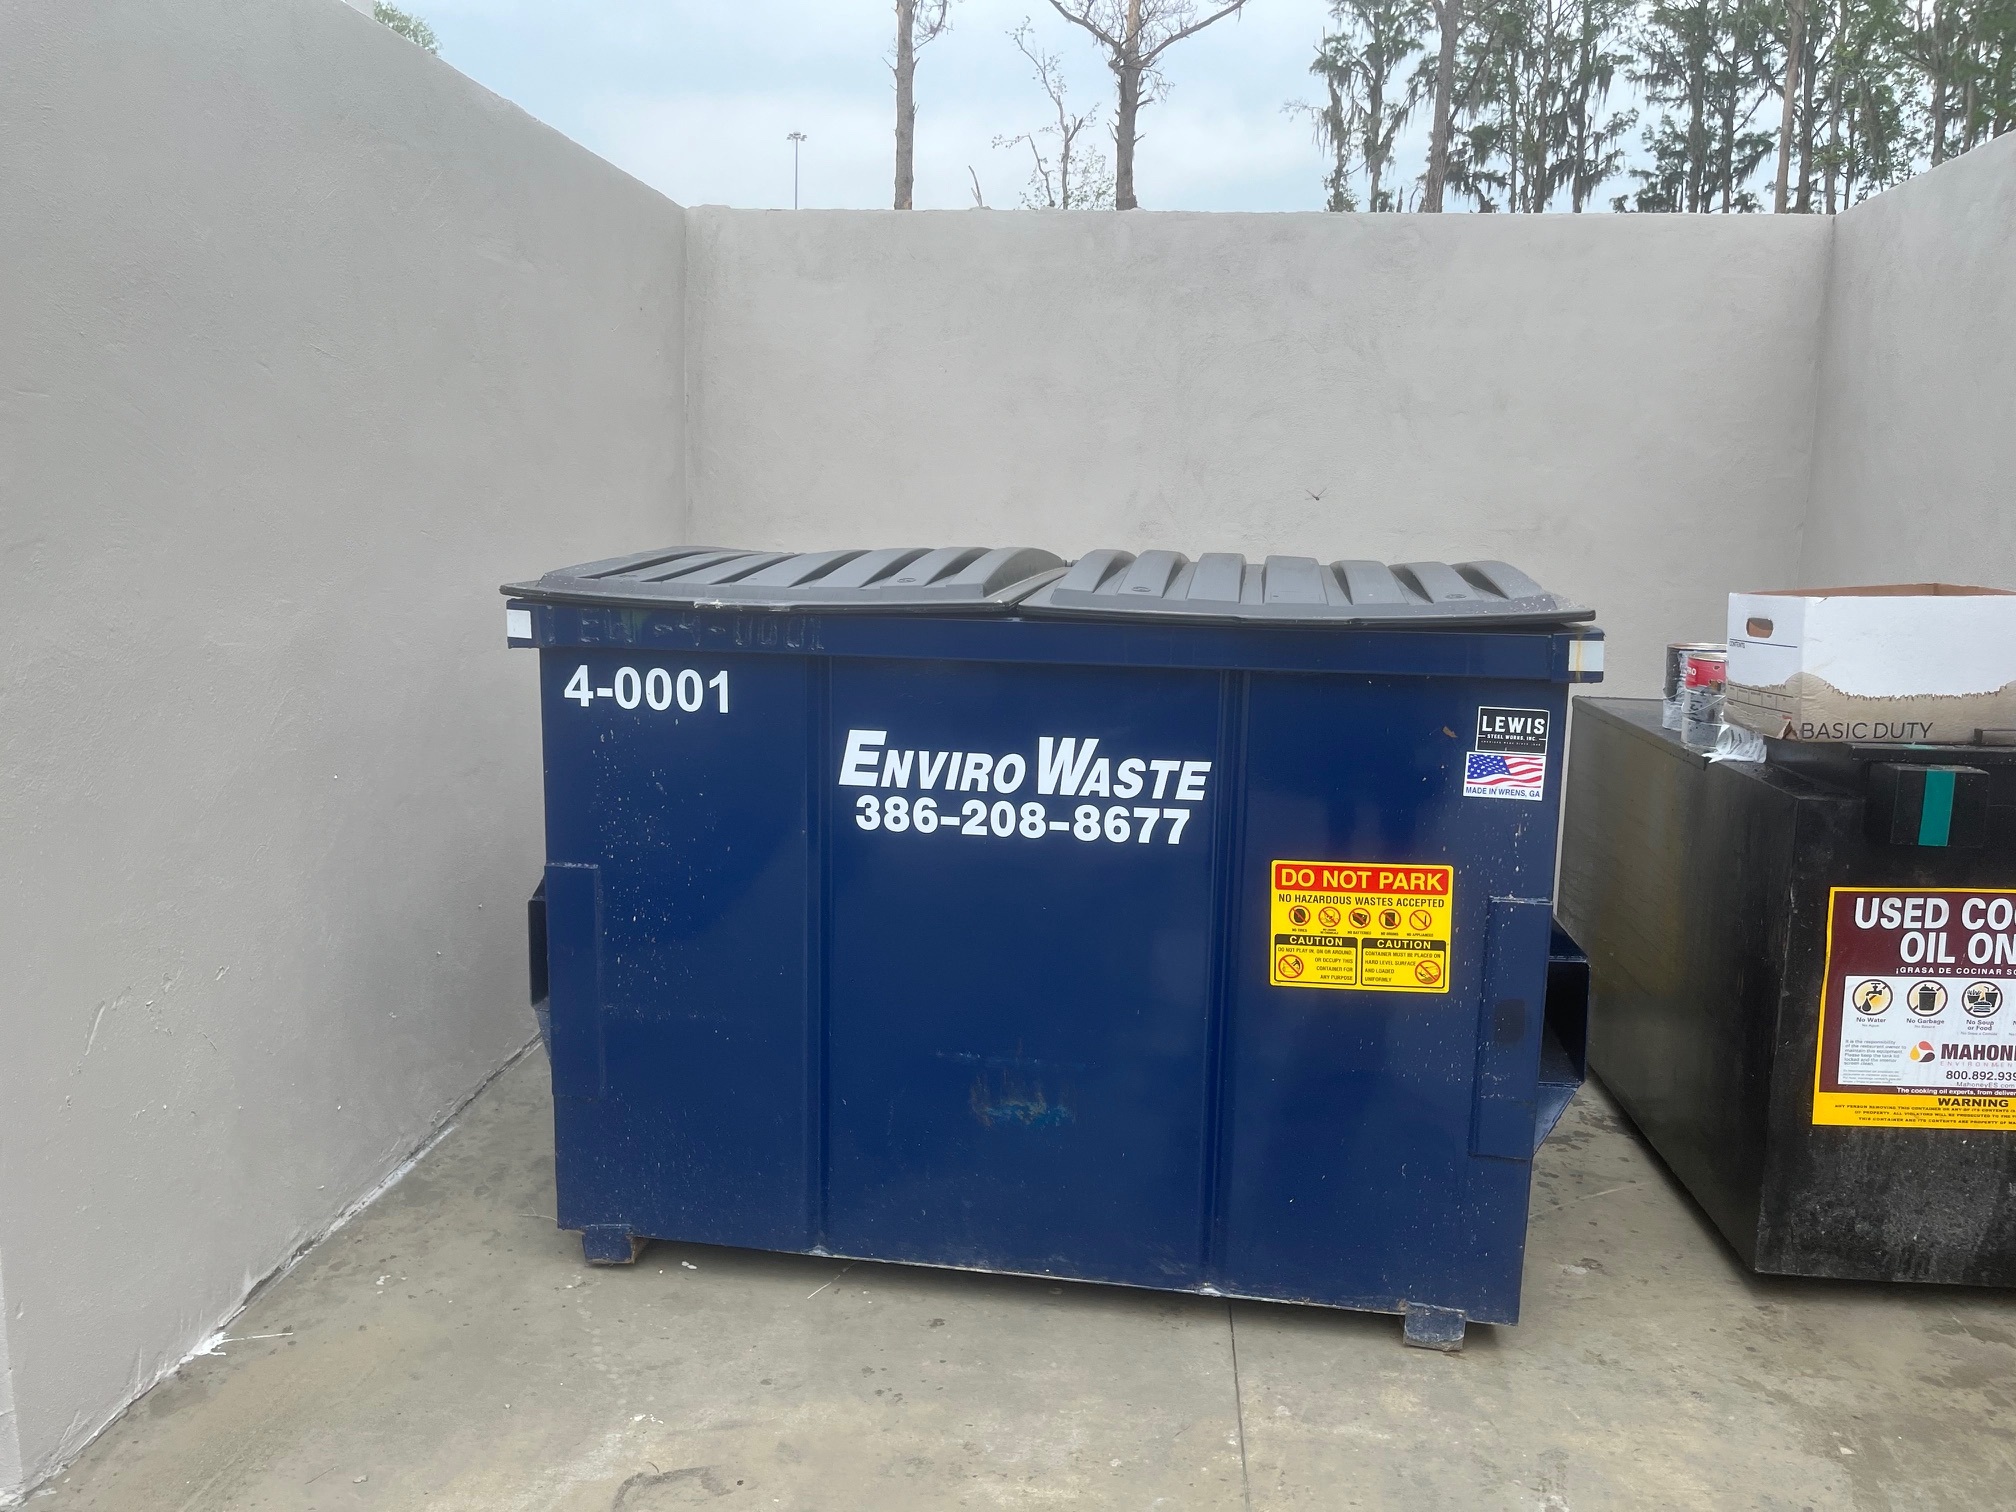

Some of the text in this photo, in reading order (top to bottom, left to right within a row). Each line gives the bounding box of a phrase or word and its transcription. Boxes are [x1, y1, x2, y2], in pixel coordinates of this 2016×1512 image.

[564, 665, 729, 713] 4-0001
[1482, 716, 1545, 734] LEWIS
[1801, 722, 1933, 739] BASIC DUTY
[838, 729, 1212, 800] ENVIRO WASTE
[1499, 789, 1527, 797] WRENS,
[855, 795, 1190, 845] 386-208-8677
[1281, 868, 1443, 891] DO NOT PARK
[1279, 894, 1444, 908] NO HAZARDOUS WASTES ACCEPTED
[1855, 897, 2016, 931] USED CO
[1289, 936, 1343, 946] CAUTION
[1377, 940, 1431, 949] CAUTION
[1900, 931, 1955, 964] OIL
[1956, 967, 2002, 975] COCINAR
[1941, 1044, 2016, 1061] MAHON
[1911, 1087, 1937, 1095] cooking
[1938, 1098, 2009, 1107] WARNING
